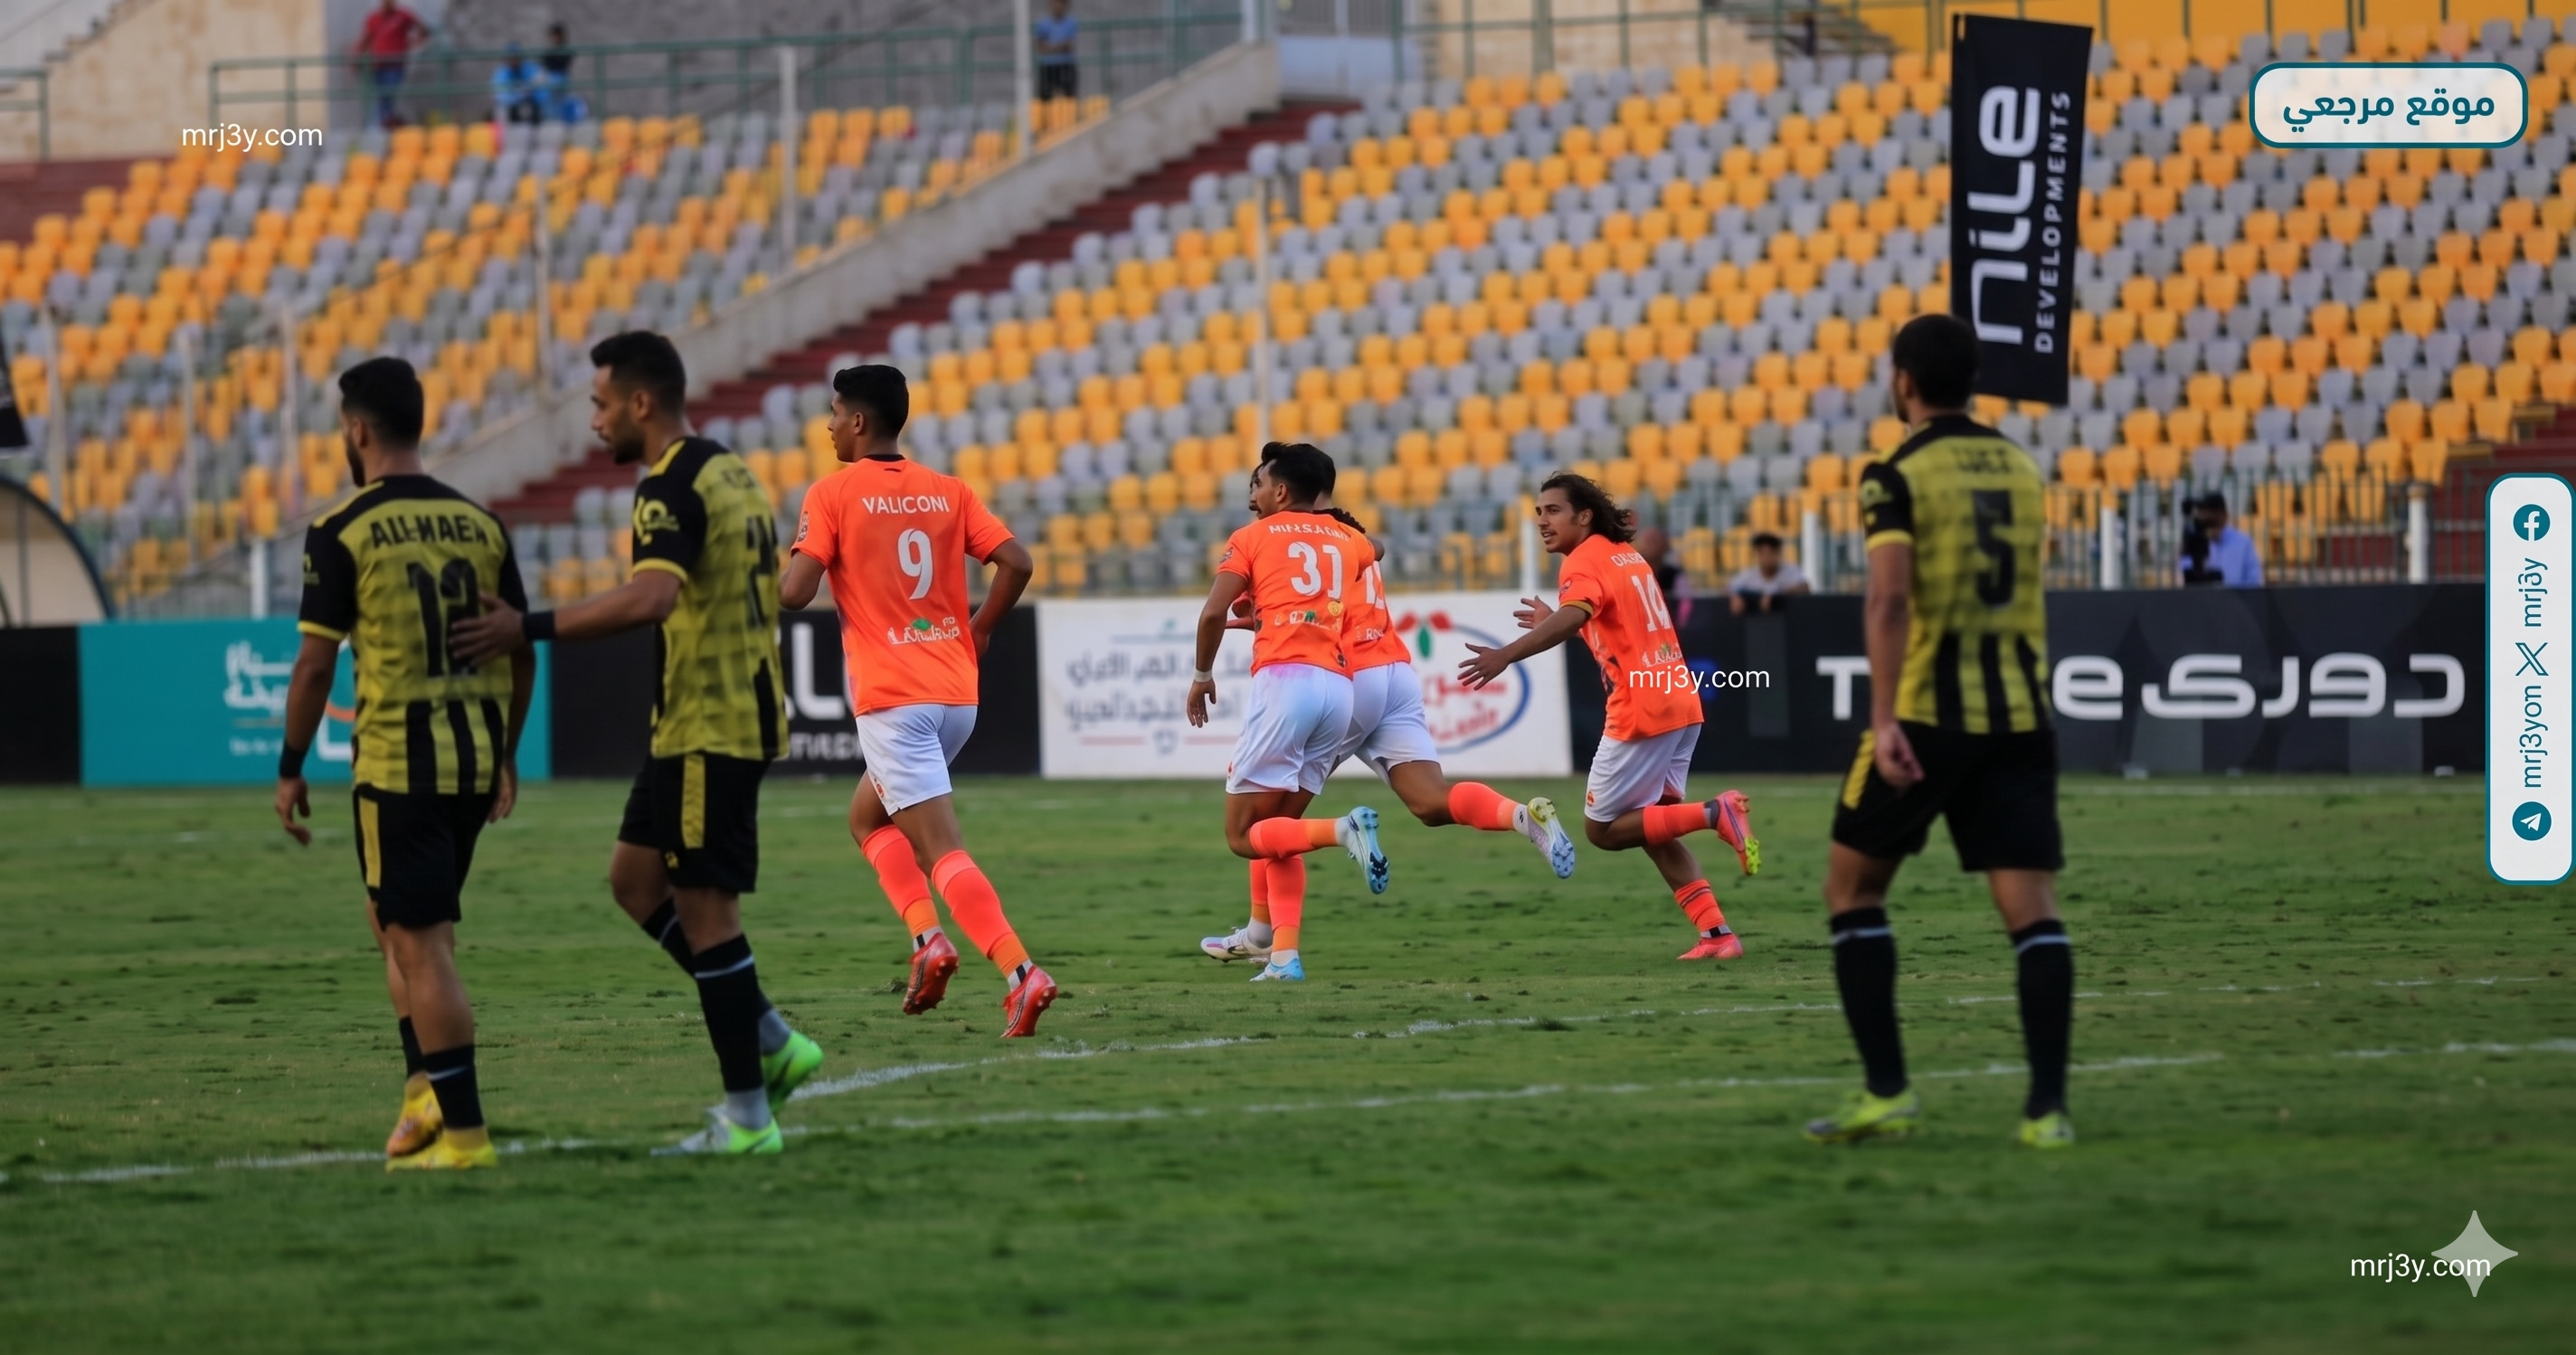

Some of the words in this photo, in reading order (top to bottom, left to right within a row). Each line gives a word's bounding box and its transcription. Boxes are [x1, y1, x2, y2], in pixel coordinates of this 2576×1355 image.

[2033, 90, 2071, 354] DEVELOPMENTS
[862, 495, 951, 515] VALICONI
[896, 527, 933, 602] 9
[1287, 541, 1343, 601] 31
[1971, 488, 2018, 609] 5
